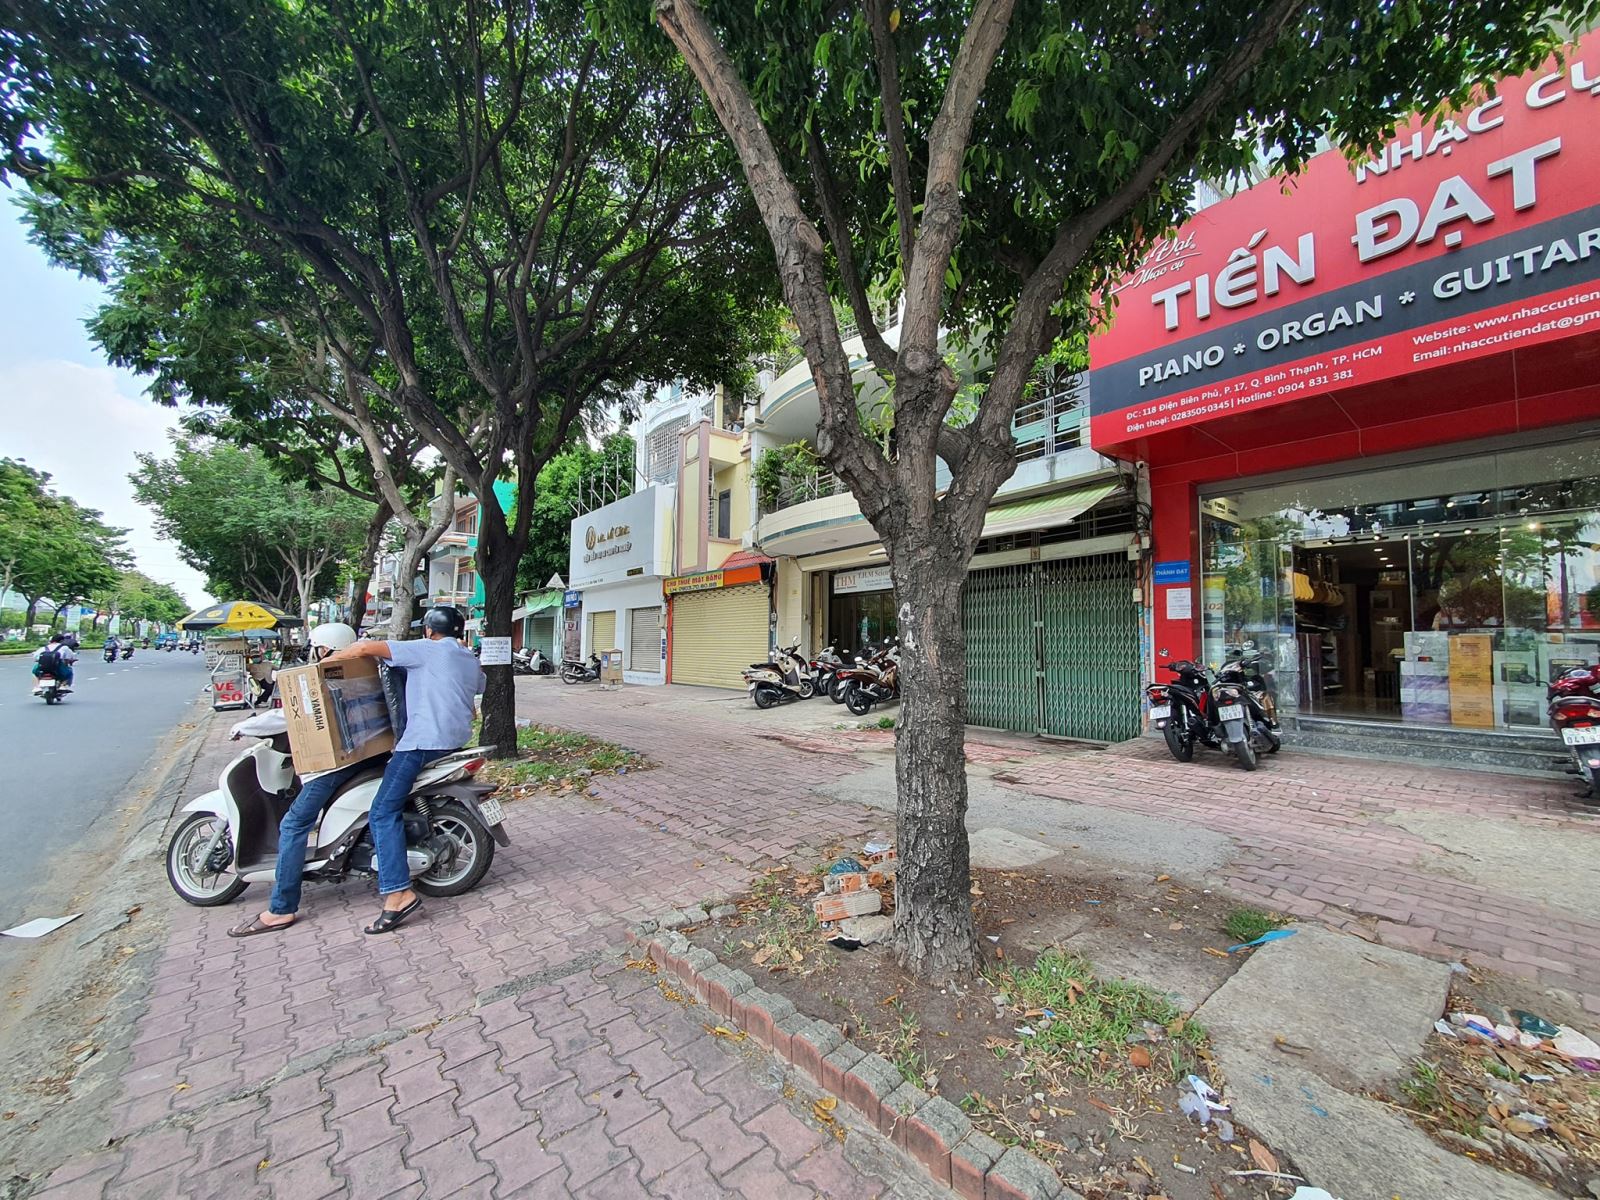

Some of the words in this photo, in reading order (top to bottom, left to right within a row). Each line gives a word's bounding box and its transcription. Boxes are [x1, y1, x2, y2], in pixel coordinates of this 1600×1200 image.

[1356, 96, 1504, 184] NHẠC
[1151, 228, 1316, 331] TIẾN
[1351, 136, 1562, 264] ĐẠT
[1139, 345, 1225, 387] PIANO
[1256, 294, 1383, 351] ORGAN
[1412, 324, 1472, 345] Website:
[1412, 346, 1452, 362] Email:
[1126, 420, 1145, 432] Điện
[1146, 416, 1170, 428] thoại:
[1237, 390, 1276, 405] Hotline:
[1277, 381, 1305, 395] 0904
[1308, 375, 1328, 387] 831
[1332, 369, 1353, 381] 381
[1158, 401, 1179, 412] Điện
[1180, 395, 1199, 406] Biên
[1264, 371, 1287, 384] Bình
[1332, 355, 1350, 366] TP.
[1352, 345, 1383, 361] HCM
[311, 698, 325, 731] YAMAHA
